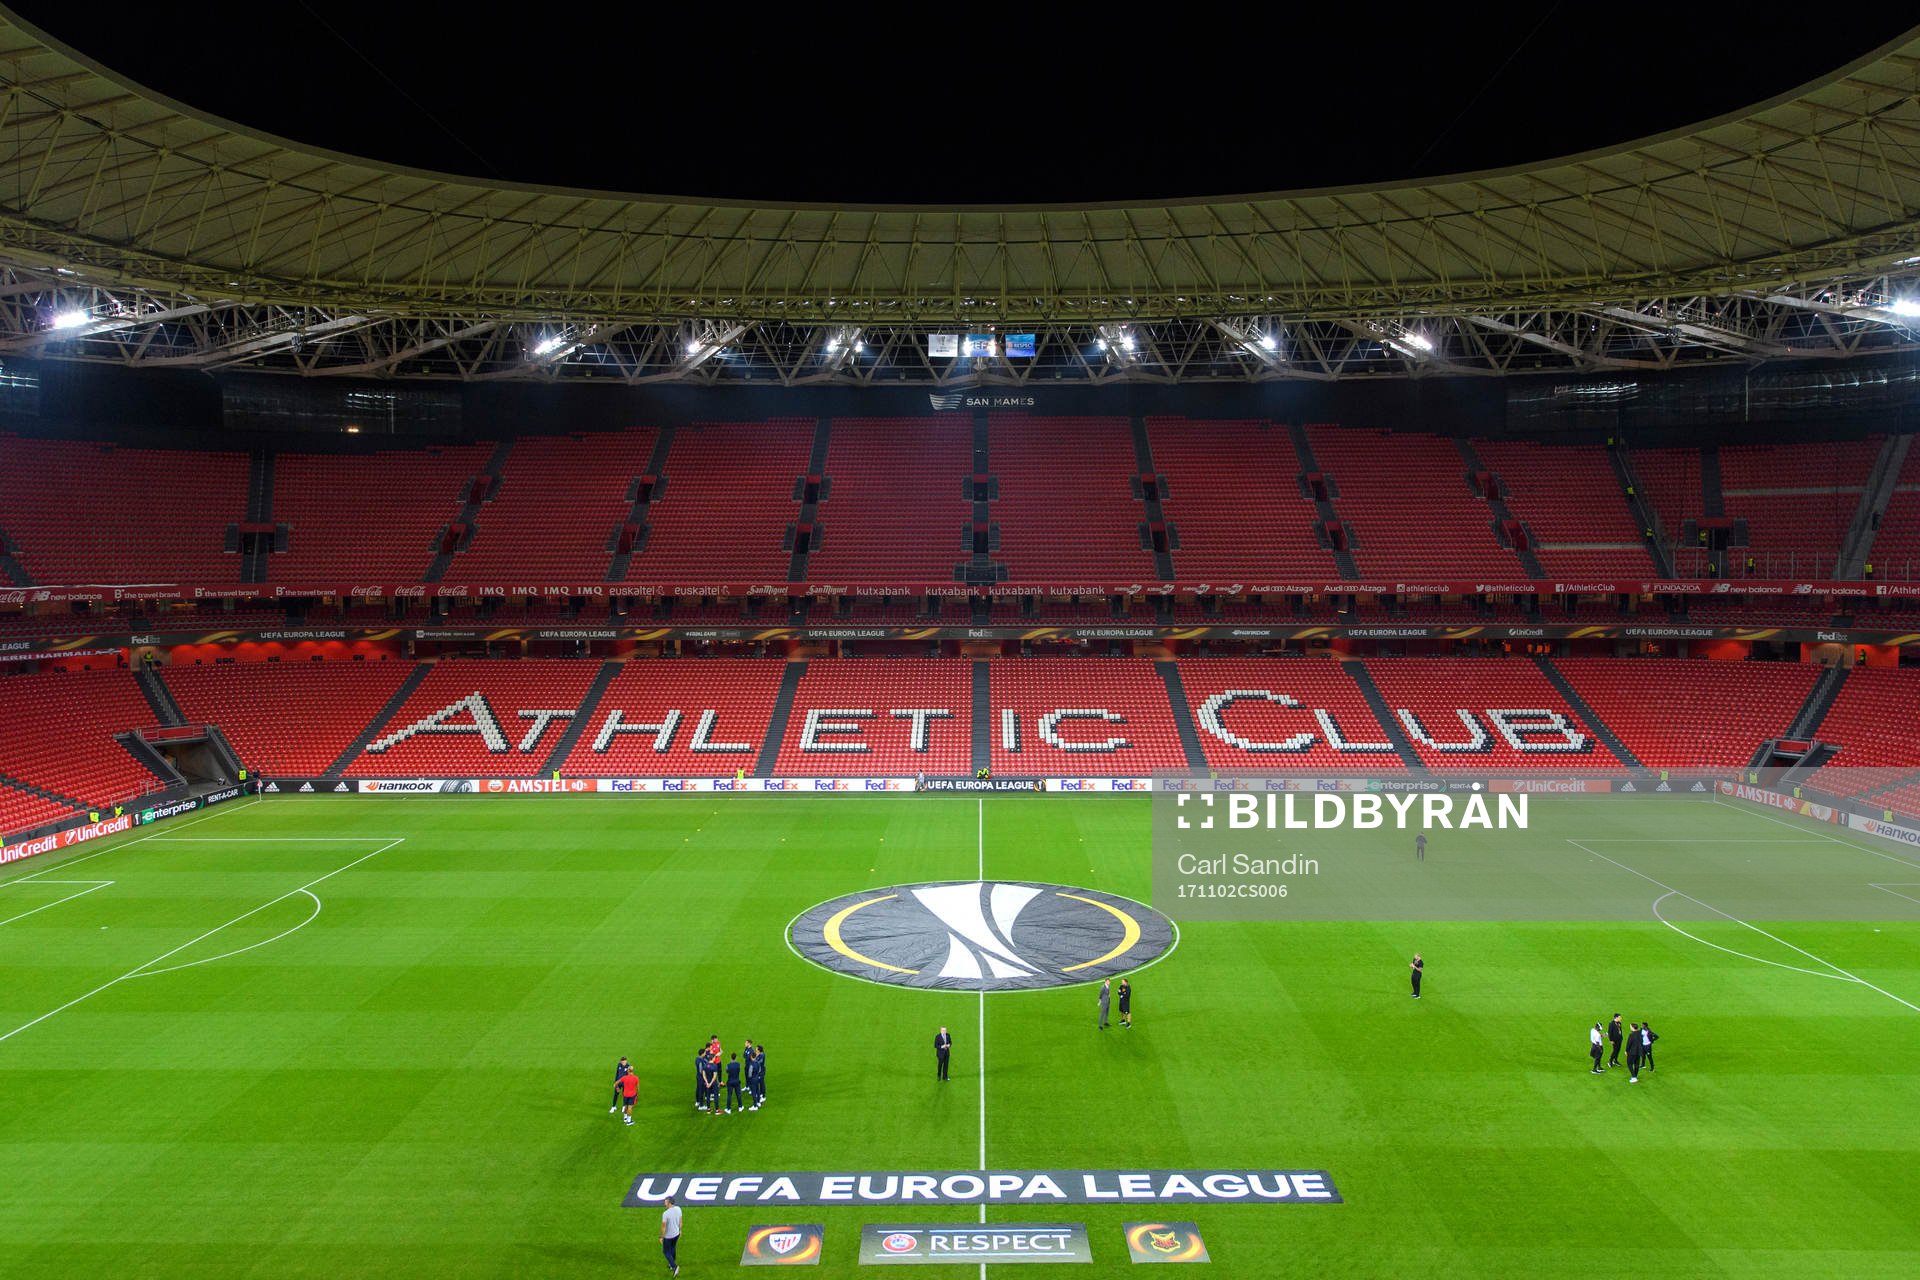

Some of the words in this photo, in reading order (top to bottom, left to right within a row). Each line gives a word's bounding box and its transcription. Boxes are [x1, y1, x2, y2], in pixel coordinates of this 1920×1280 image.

[966, 398, 989, 406] SAN
[204, 590, 216, 598] the
[217, 589, 239, 597] travel
[285, 588, 297, 596] the
[298, 588, 318, 596] travel
[318, 588, 337, 596] brand
[479, 587, 505, 596] IMQ
[512, 587, 538, 596] IMQ
[544, 587, 570, 596] IMQ
[577, 587, 603, 596] IMQ
[609, 586, 655, 596] euskaltel
[674, 586, 720, 596] euskaltel
[856, 586, 911, 596] kutxabank
[925, 586, 980, 596] kutxabank
[988, 585, 1043, 596] kutxabank
[1050, 586, 1105, 596] kutxabank
[1251, 585, 1270, 593] Audi
[1285, 585, 1314, 593] Alzaga
[1323, 585, 1343, 593] Audi
[1359, 585, 1387, 593] Alzaga
[1405, 584, 1450, 592] athleticclub
[1748, 585, 1783, 593] balance
[1832, 587, 1867, 595] balance
[68, 593, 102, 601] balance
[124, 591, 137, 599] the
[138, 591, 159, 599] travel
[160, 590, 181, 598] brand
[260, 631, 282, 639] UEFA
[283, 630, 314, 639] EUROPA
[315, 630, 345, 638] LEAGUE
[968, 629, 993, 637] Fed
[365, 690, 1134, 754] ATHLETIC
[1196, 689, 1596, 754] CLUB
[507, 779, 570, 792] AMSTEL
[612, 780, 646, 791] FedEx
[662, 780, 697, 791] FedEx
[713, 780, 748, 791] FedEx
[764, 780, 798, 791] FedEx
[814, 780, 849, 791] FedEx
[865, 780, 900, 791] FedEx
[928, 781, 954, 790] UEFA
[955, 781, 994, 790] EUROPA
[996, 781, 1034, 790] LEAGUE
[1061, 780, 1095, 791] FedEx
[1112, 780, 1146, 791] FedEx
[1162, 780, 1198, 791] FedEx
[1214, 780, 1249, 791] FedEx
[1265, 780, 1300, 791] FedEx
[1316, 780, 1352, 791] FedEx
[1370, 780, 1439, 792] enterprise
[1526, 780, 1586, 792] UniCredit
[1735, 784, 1783, 807] AMSTEL
[142, 800, 197, 822] enterprise
[207, 788, 239, 804] RENT-A-CAR
[77, 817, 129, 842] UniCredit
[0, 835, 57, 864] UniCredit
[637, 1176, 801, 1202] UEFA
[819, 1174, 1068, 1200] EUROPA
[1083, 1173, 1332, 1199] LEAGUE
[930, 1234, 1072, 1251] RESPECT
